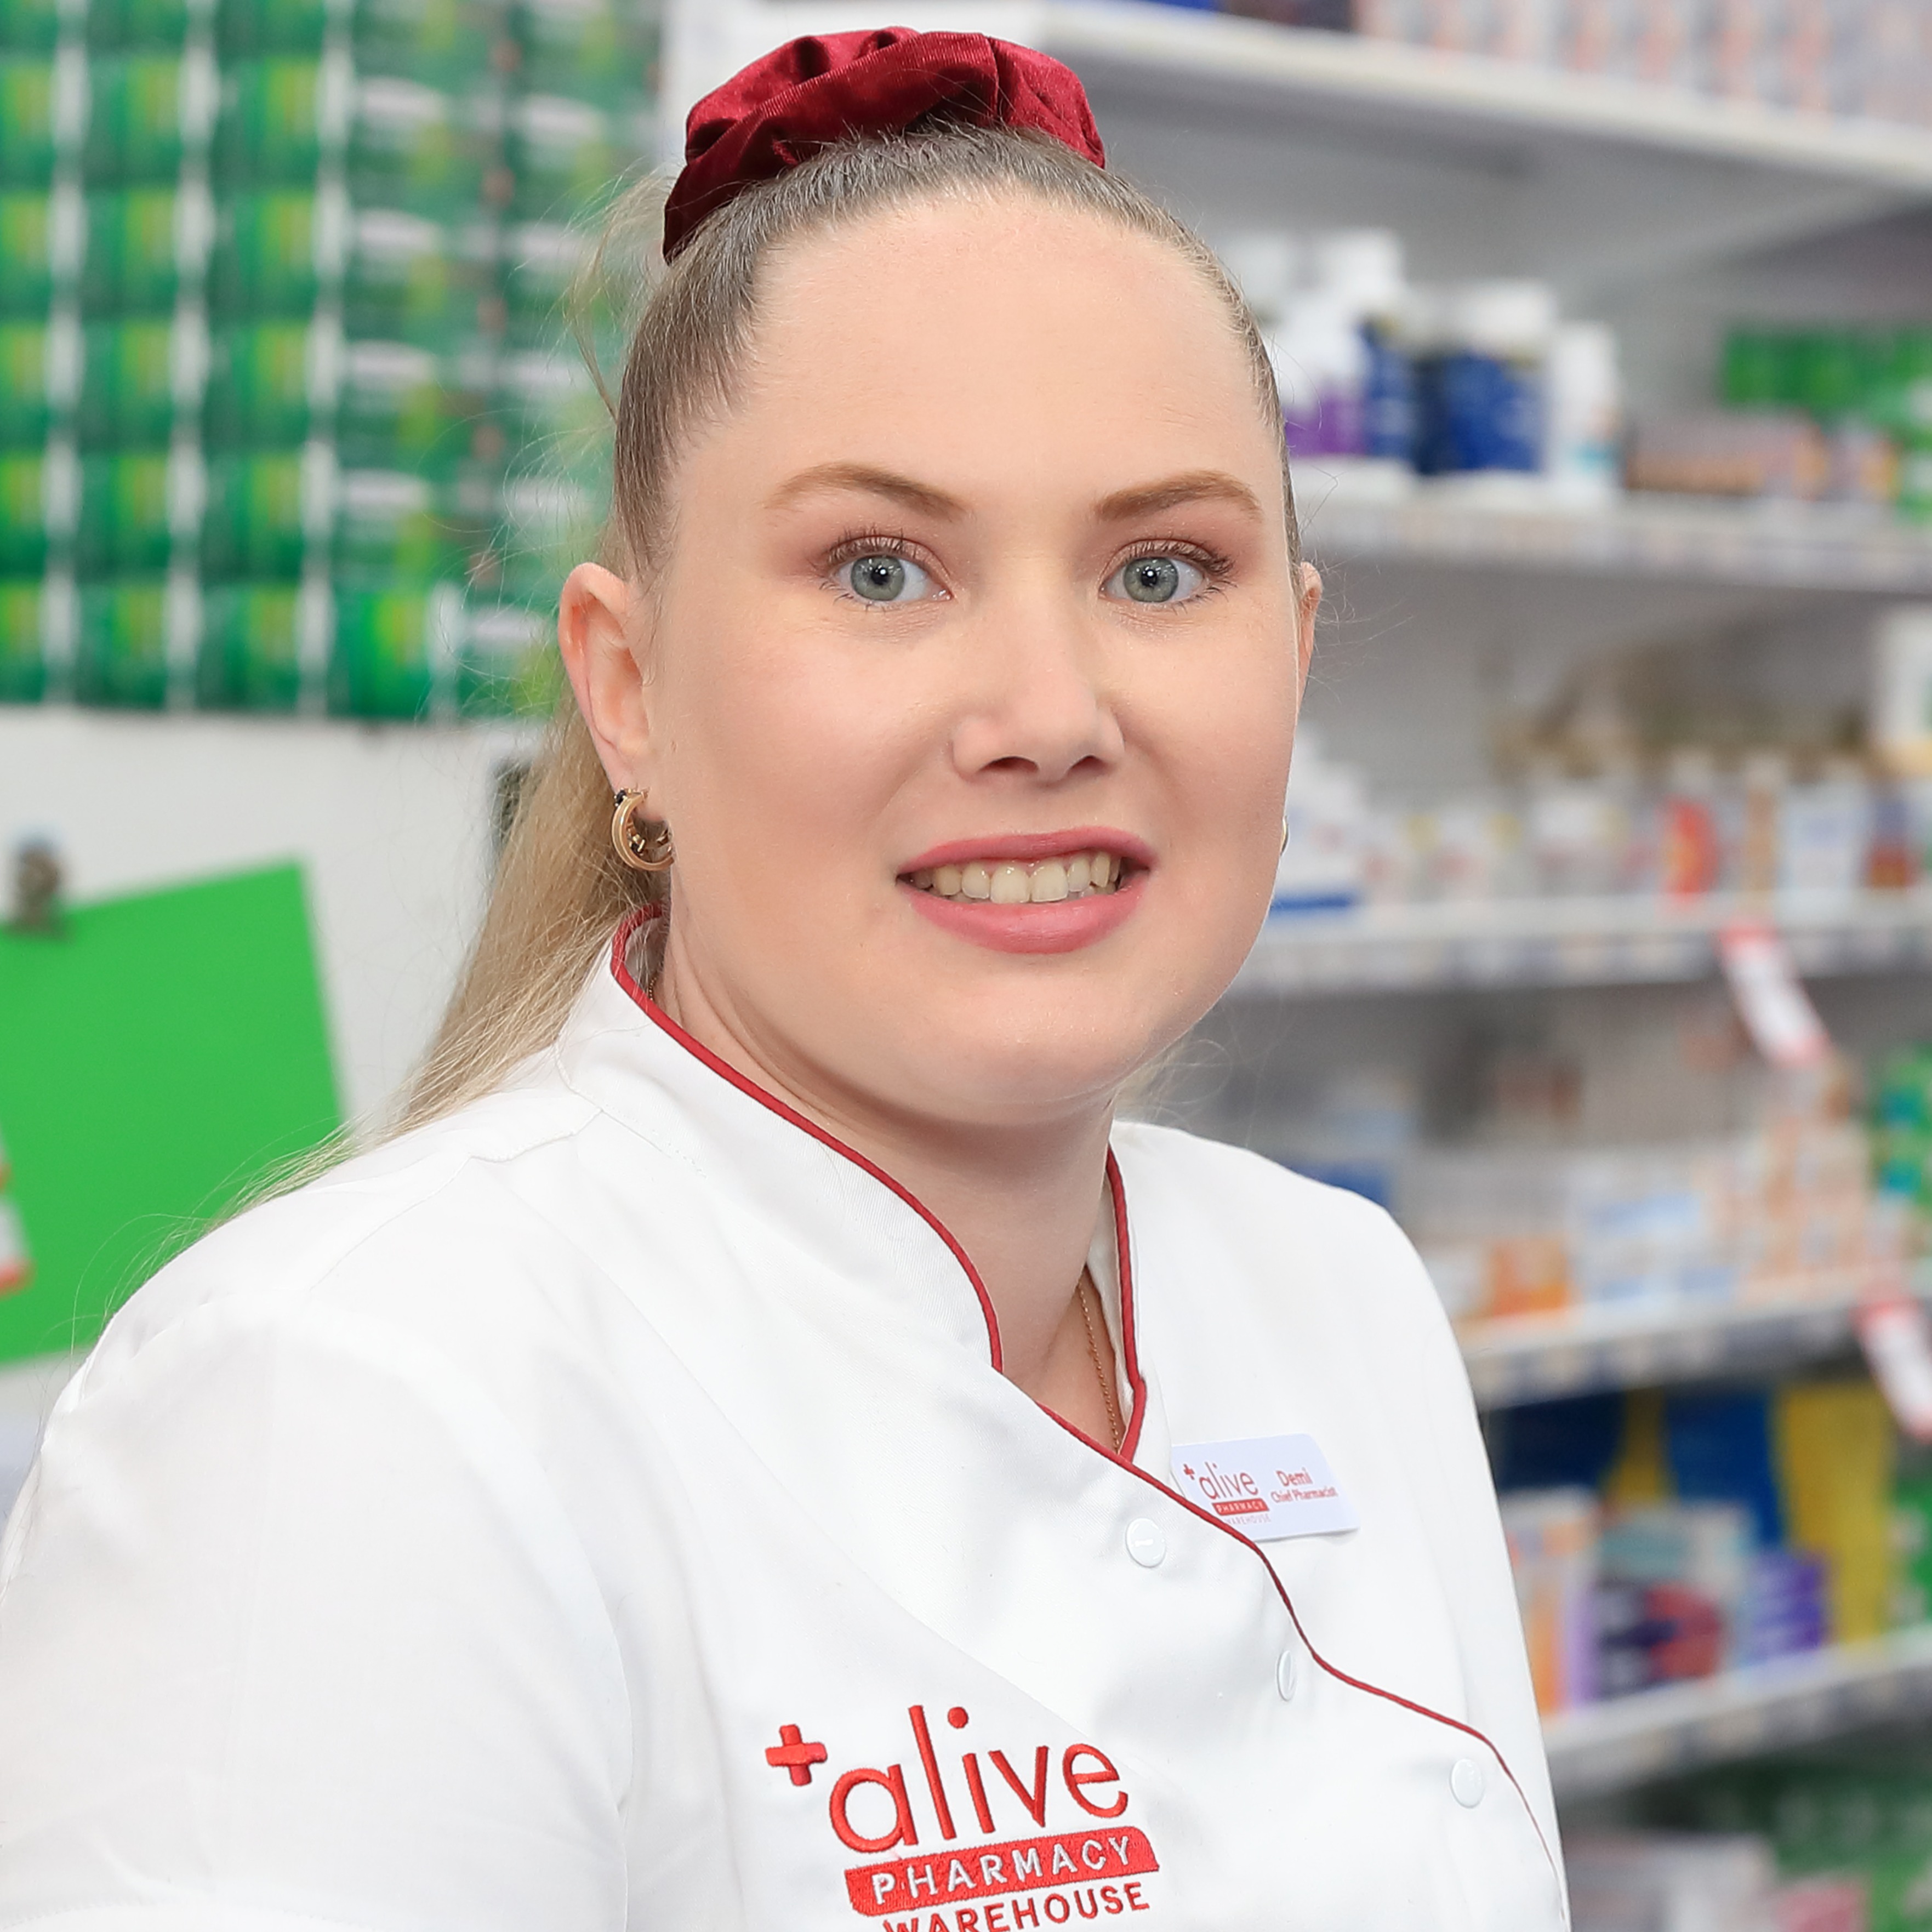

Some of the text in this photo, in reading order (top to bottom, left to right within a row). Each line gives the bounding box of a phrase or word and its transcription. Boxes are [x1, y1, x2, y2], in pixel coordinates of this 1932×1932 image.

[1199, 1462, 1259, 1500] alive
[1275, 1466, 1313, 1486] Demi
[1216, 1501, 1264, 1513] PHARMACY
[1270, 1486, 1338, 1503] Chief Pharmacist
[829, 1705, 1129, 1853] alive
[871, 1836, 1130, 1905] PHARMACY
